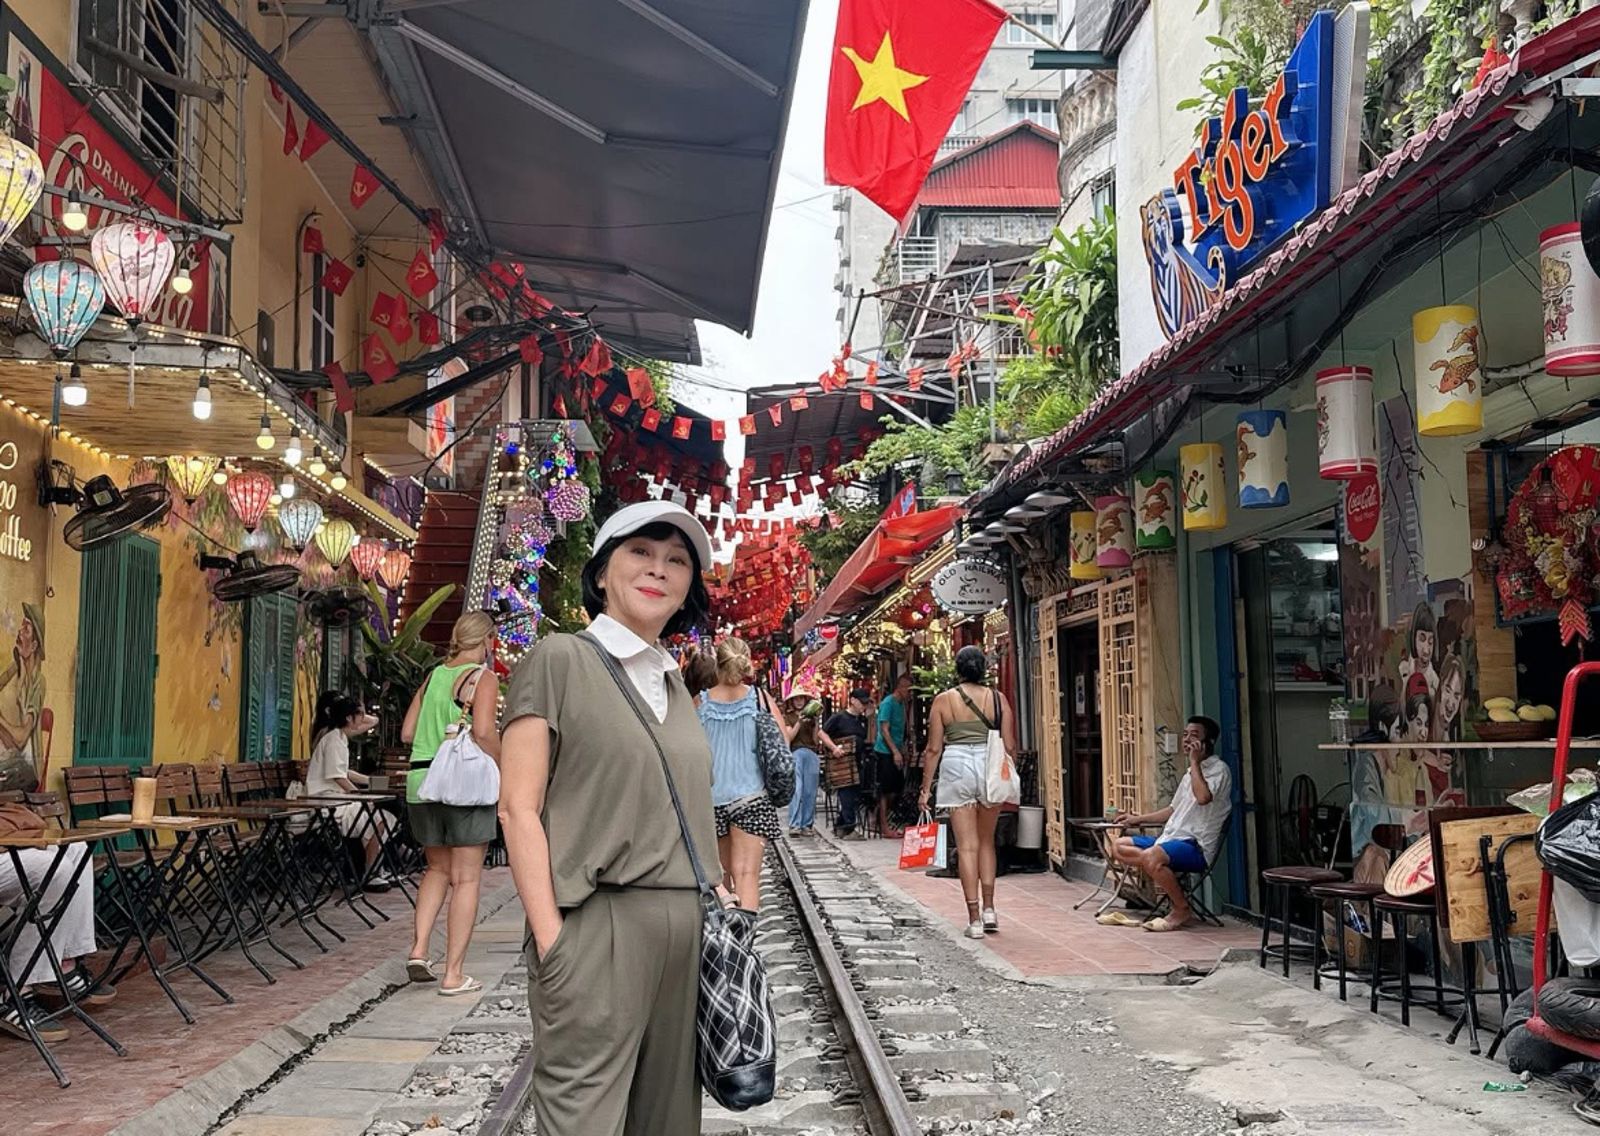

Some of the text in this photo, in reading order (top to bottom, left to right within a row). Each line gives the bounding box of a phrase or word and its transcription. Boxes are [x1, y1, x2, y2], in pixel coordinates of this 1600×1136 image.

[1174, 72, 1289, 251] Tiger
[0, 514, 31, 561] offee
[938, 564, 1006, 586] OLD RAILWAY
